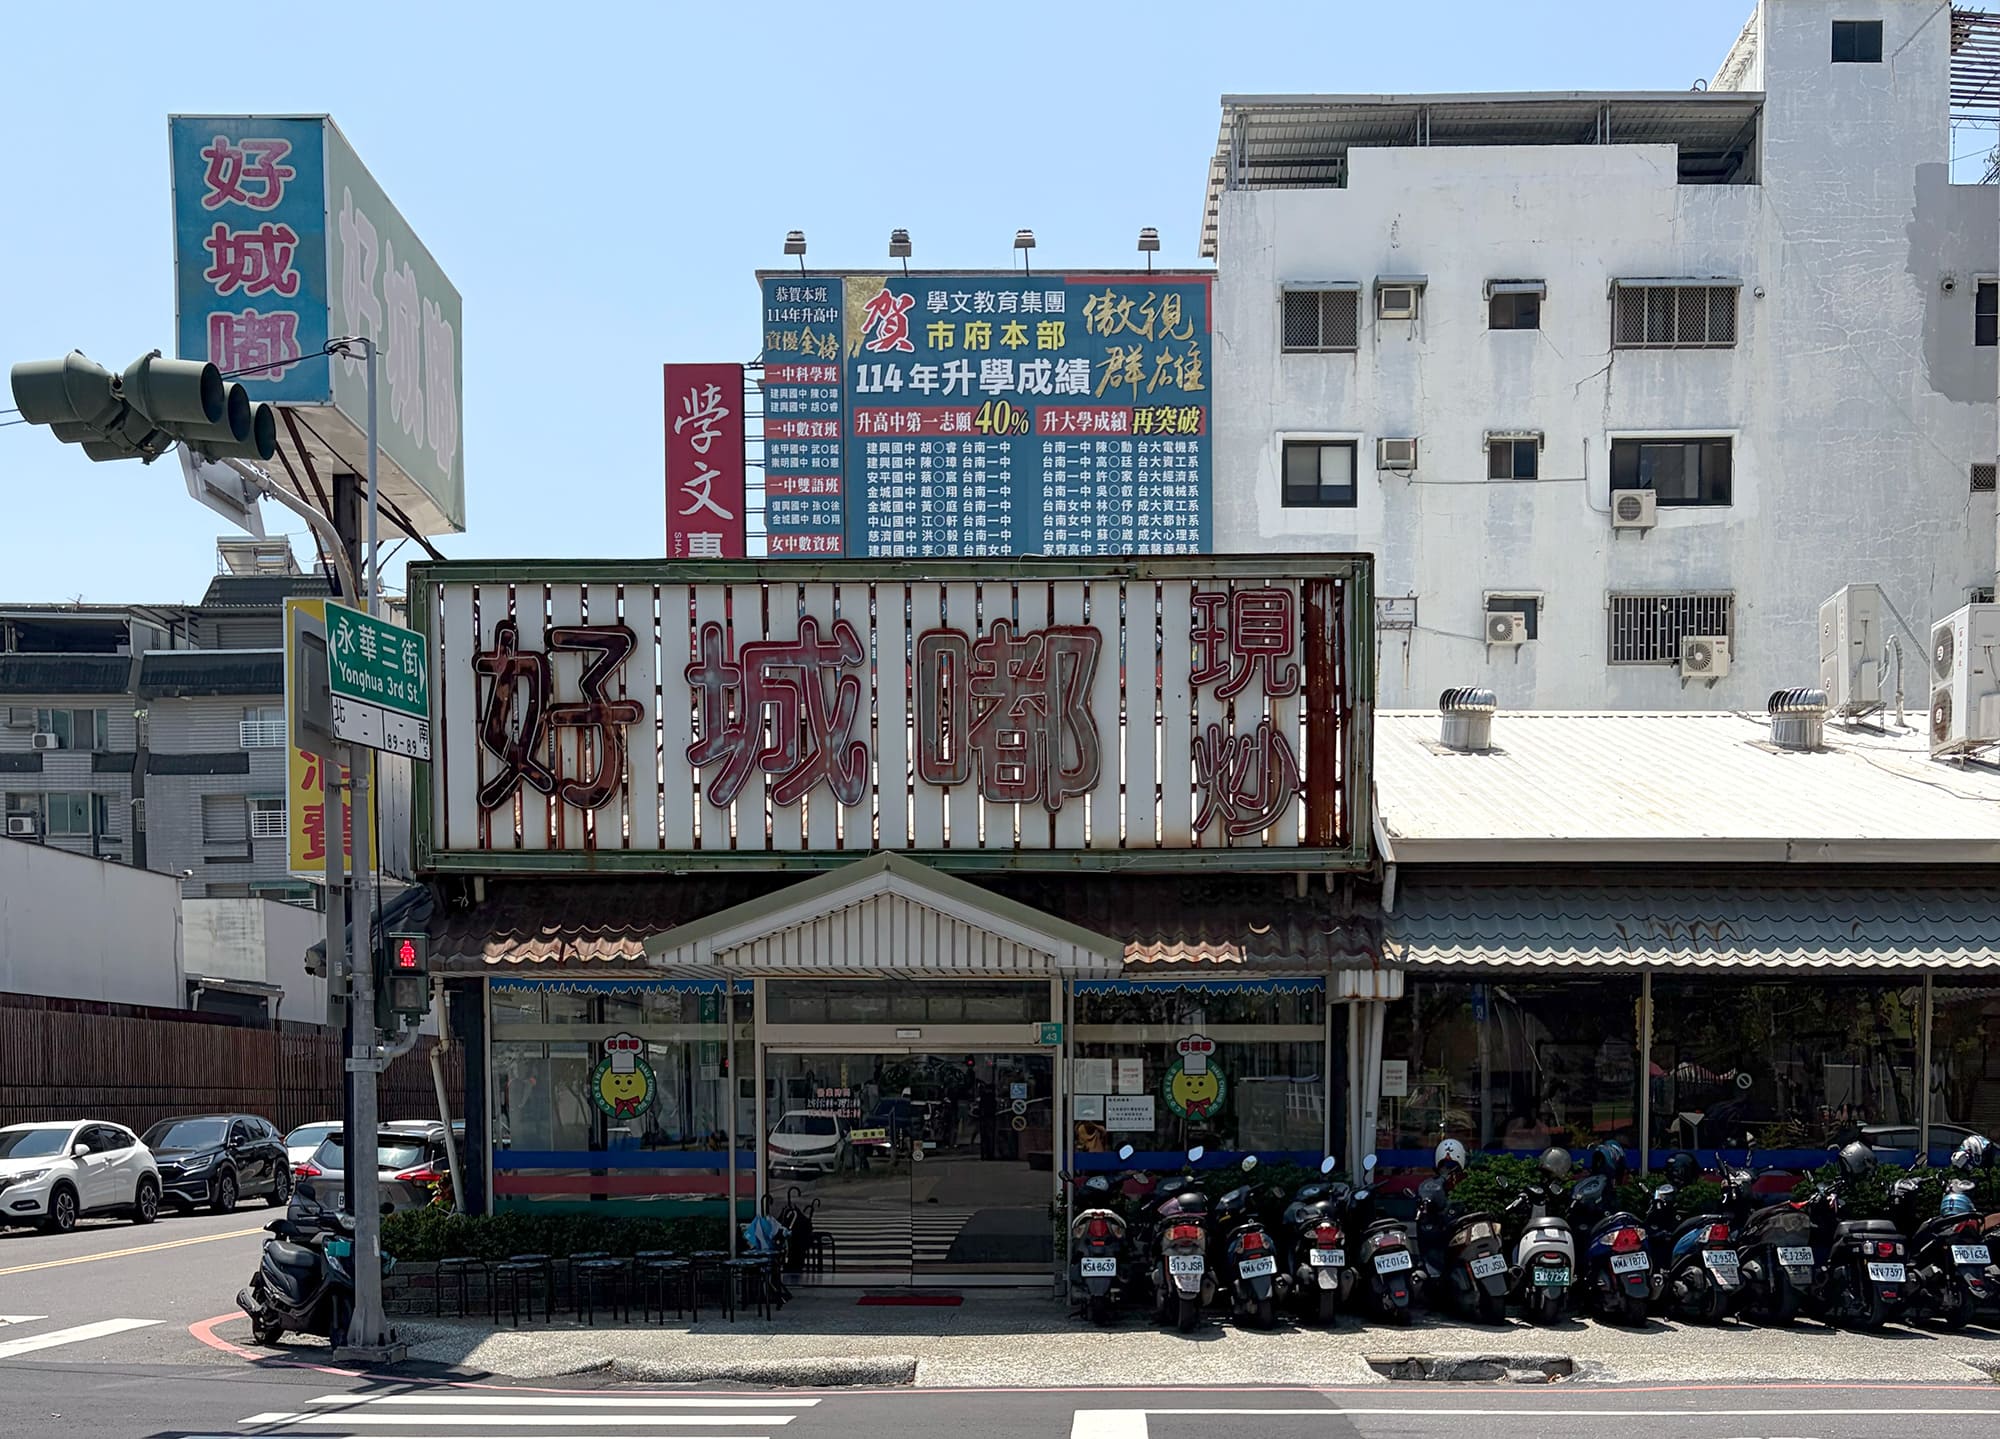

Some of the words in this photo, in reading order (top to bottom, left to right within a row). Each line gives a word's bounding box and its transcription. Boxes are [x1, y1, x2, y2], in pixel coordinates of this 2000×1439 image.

[200, 134, 299, 383] 好城嘟
[776, 286, 827, 303] 恭賀本班
[926, 290, 1066, 314] 學文教育集團
[767, 307, 838, 323] 114年升高中
[860, 288, 916, 353] 賀
[765, 325, 840, 360] 資優金榜
[926, 320, 1066, 351] 市府本部
[767, 366, 837, 382] 一中科學班
[855, 358, 1091, 396] 114年升學成績
[1094, 340, 1206, 402] 群雄
[857, 411, 972, 433] 升高中第一志願
[974, 400, 1029, 435] 40%
[1042, 411, 1127, 432] 升大學成績
[1132, 407, 1201, 435] 再突破
[768, 421, 838, 438] 一中數資班
[866, 442, 915, 454] 建興國中
[962, 442, 1010, 454] 台南一中
[1042, 441, 1091, 453] 台南一中
[867, 457, 915, 469] 建興國中
[962, 457, 1011, 469] 台南一中
[1042, 456, 1091, 468] 台南一中
[867, 472, 915, 484] 安平國中
[962, 472, 1011, 484] 台南一中
[1042, 470, 1091, 482] 台南一中
[769, 477, 839, 494] 一中雙語班
[867, 486, 916, 498] 金城國中
[962, 486, 1011, 498] 台南一中
[1042, 485, 1091, 497] 台南一中
[867, 501, 916, 513] 金城國中
[962, 501, 1011, 513] 台南一中
[1042, 500, 1091, 512] 台南女中
[867, 516, 916, 528] 中山國中
[963, 516, 1011, 528] 台南一中
[1042, 514, 1091, 526] 台南女中
[770, 535, 840, 552] 女中數資班
[868, 530, 916, 542] 慈濟國中
[963, 530, 1011, 542] 台南一中
[1042, 529, 1091, 541] 台南一中
[868, 545, 917, 556] 建興國中
[963, 545, 1011, 556] 台南女中
[336, 616, 420, 678] 永華三街
[338, 660, 384, 694] Yonghua
[386, 676, 405, 700] 3rd
[407, 683, 421, 705] St.
[334, 698, 346, 723] 北
[472, 615, 1105, 811] 好城嘟
[1188, 587, 1302, 838] 現炒
[418, 722, 430, 744] 南
[387, 733, 417, 756] 89-89
